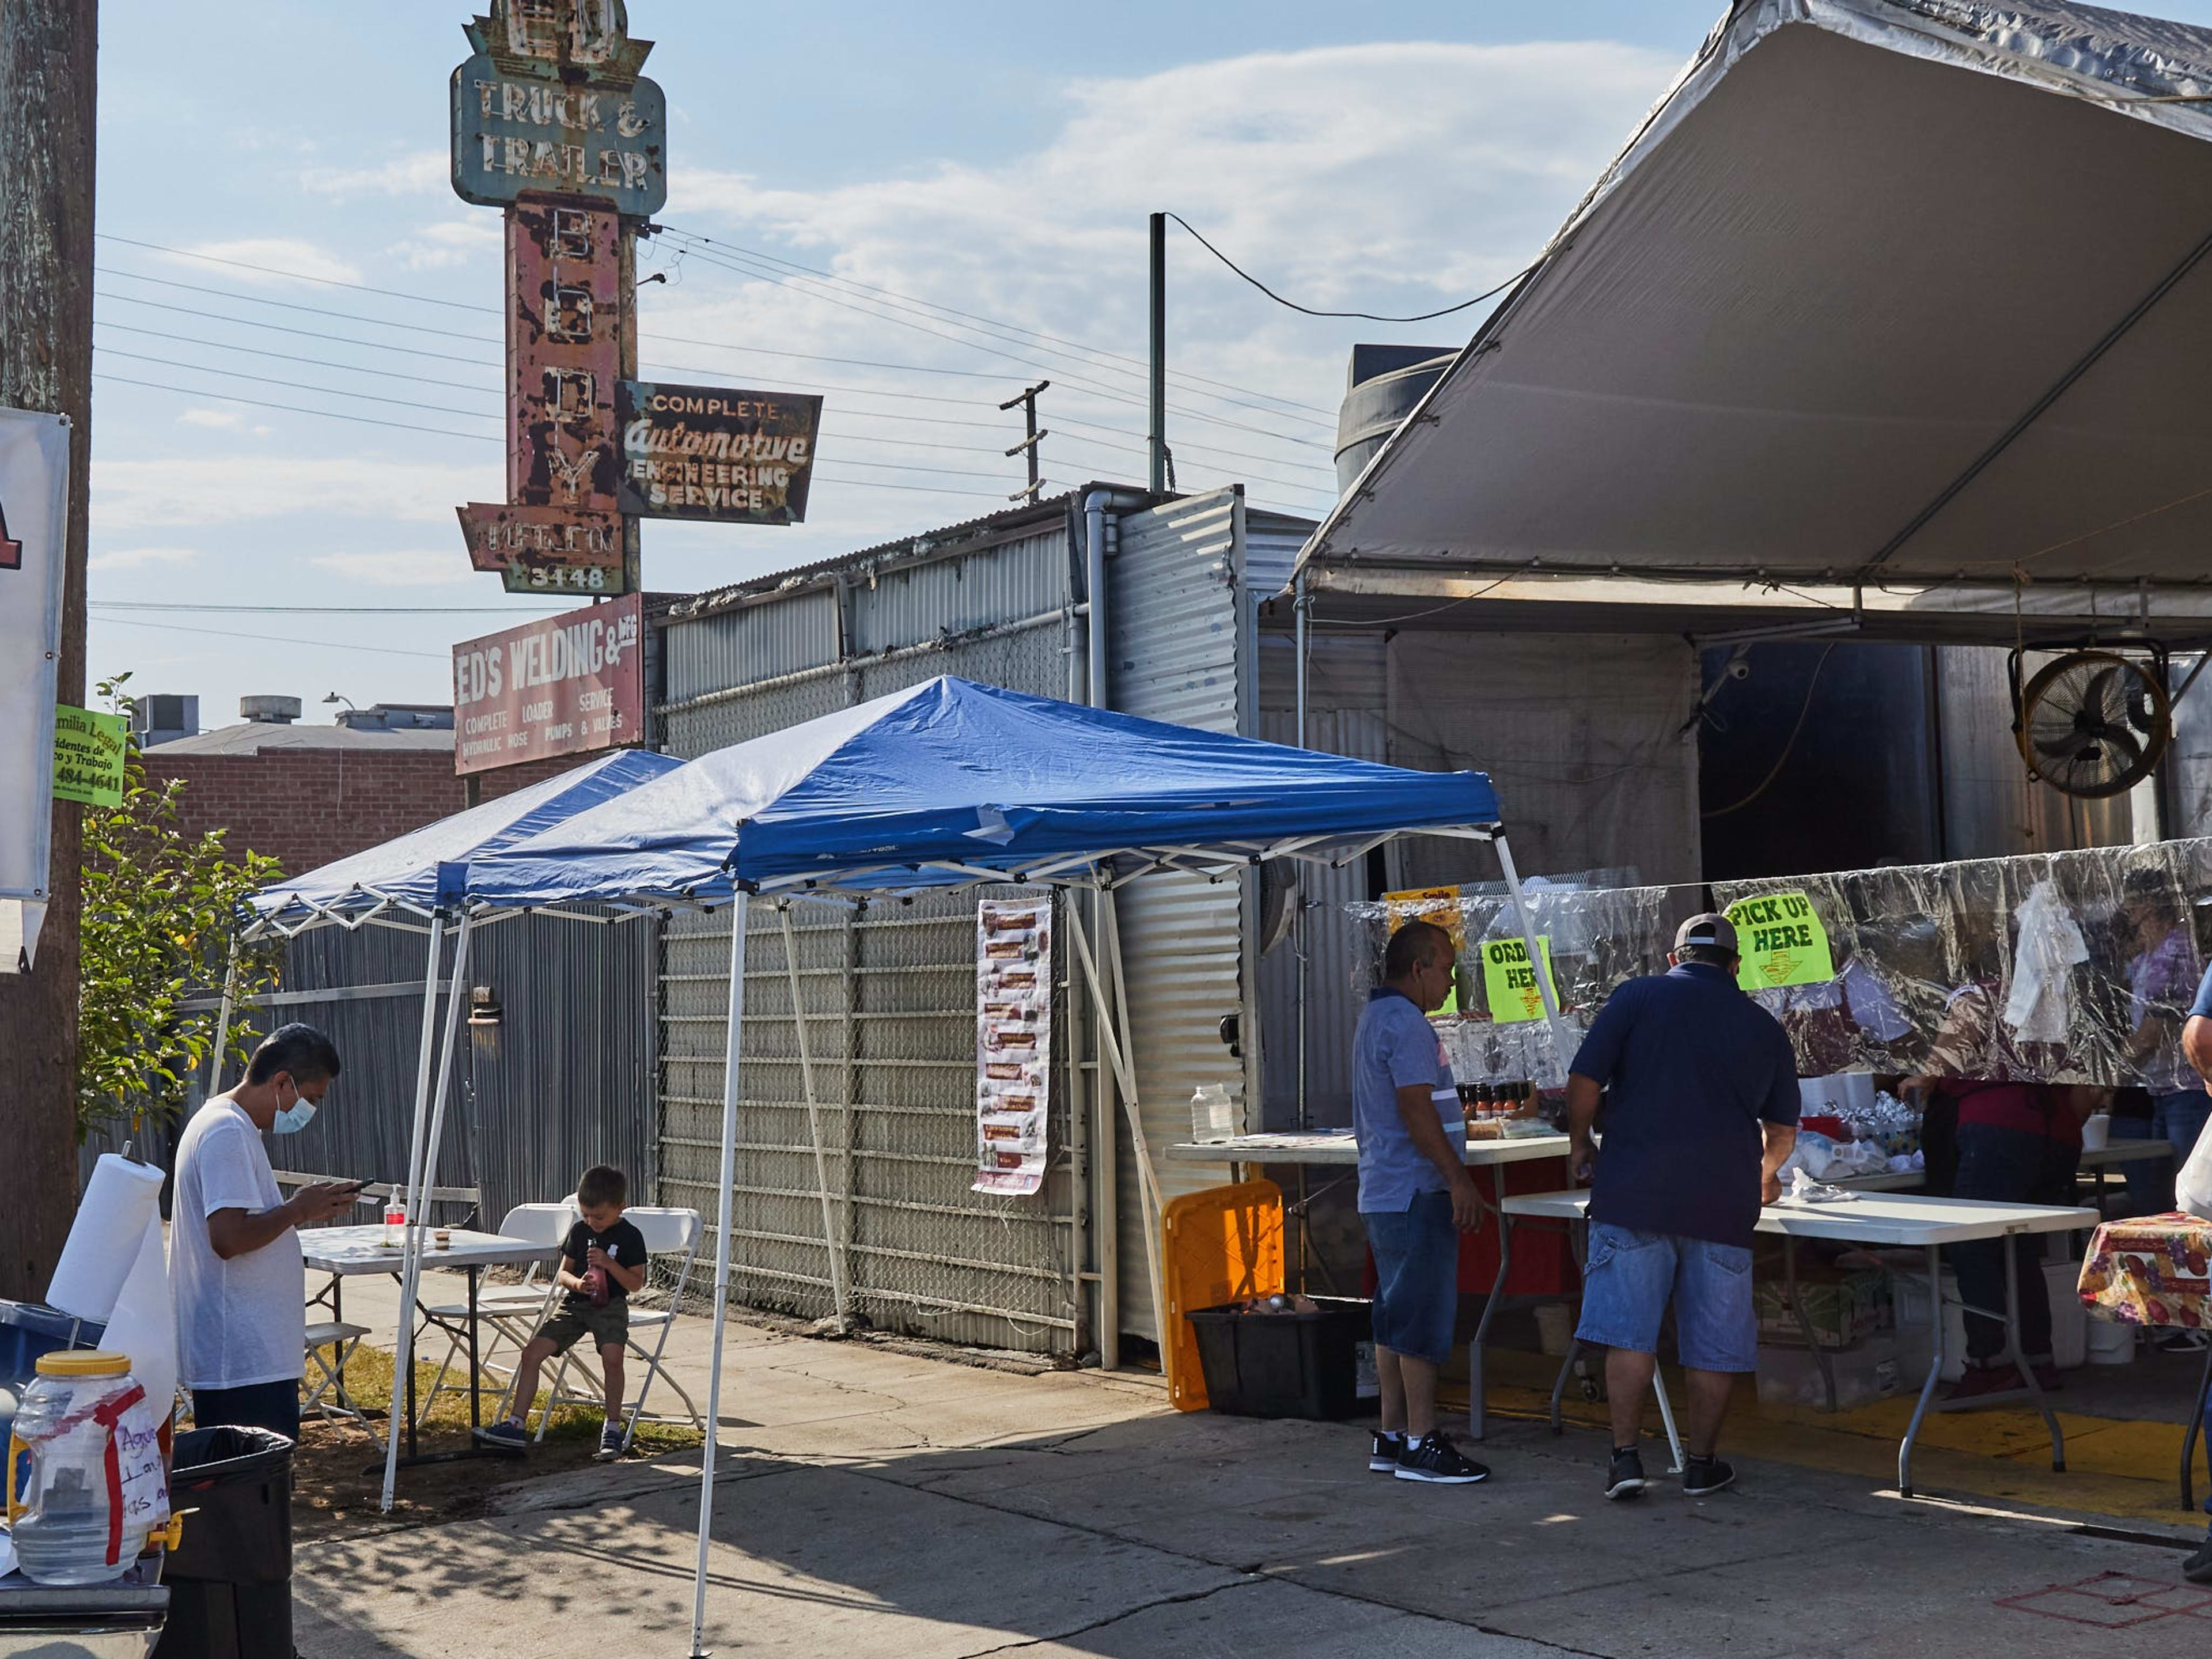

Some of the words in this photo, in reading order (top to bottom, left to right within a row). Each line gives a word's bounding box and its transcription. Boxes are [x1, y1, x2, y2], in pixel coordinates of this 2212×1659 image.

[475, 79, 604, 132] TRUCK
[618, 101, 650, 138] &
[476, 132, 648, 191] TRAILER
[652, 395, 779, 420] COMPLETE
[633, 459, 789, 487] ENGINEERING
[649, 483, 763, 509] SERVICE
[456, 646, 502, 706] ED'S
[509, 619, 604, 691] WELDING
[605, 626, 621, 666] &
[465, 710, 508, 735] COMPLETE
[522, 700, 554, 724] LOADER
[579, 687, 614, 712] SERVICE
[89, 721, 122, 755] Legal
[463, 736, 502, 757] HYDRAULIC
[507, 731, 528, 749] HOSE
[544, 723, 574, 742] PUMPS
[581, 721, 588, 736] &
[593, 714, 623, 733] VALVES
[65, 754, 73, 764] y
[75, 753, 113, 771] Trabajo
[93, 746, 105, 757] de
[1728, 899, 1783, 926] PICK
[1783, 896, 1809, 919] UP
[1753, 924, 1813, 952] HERE
[1490, 942, 1542, 964] ORD
